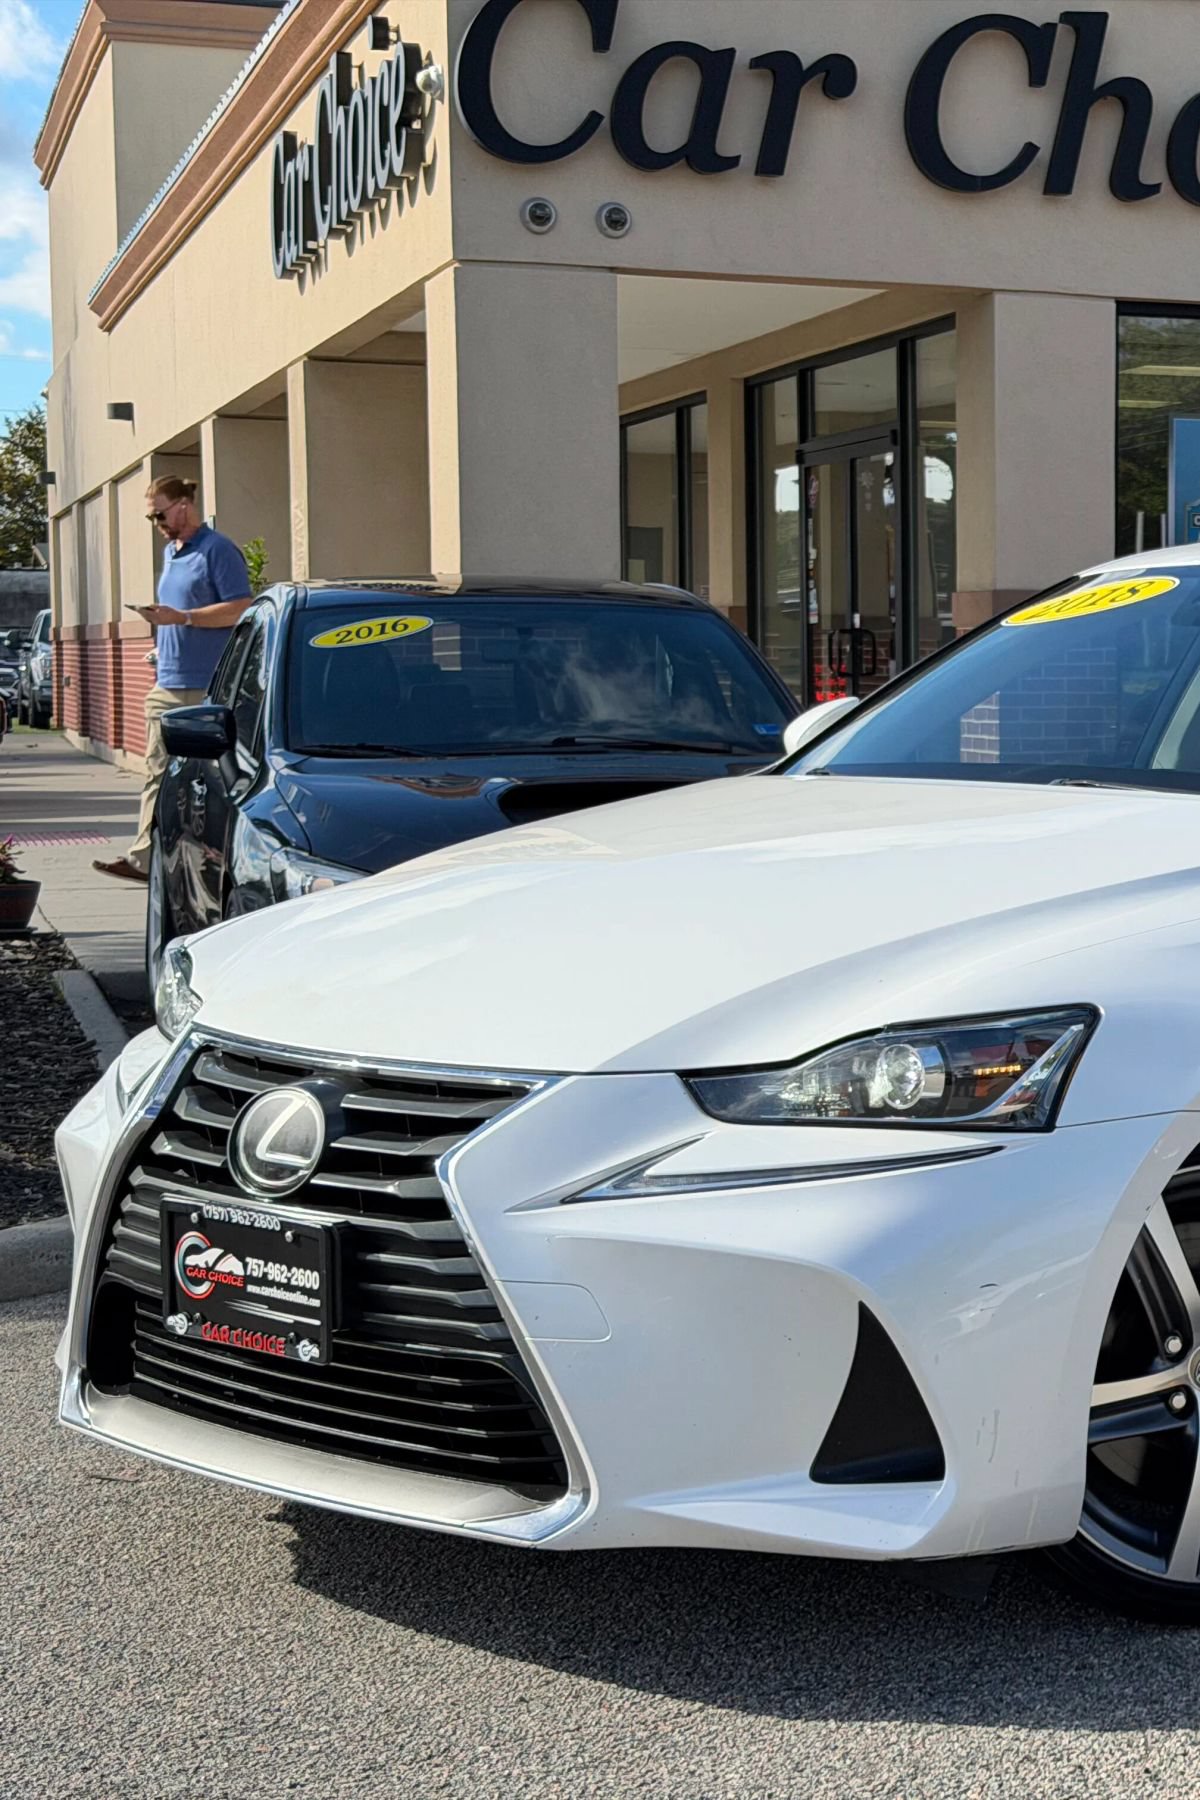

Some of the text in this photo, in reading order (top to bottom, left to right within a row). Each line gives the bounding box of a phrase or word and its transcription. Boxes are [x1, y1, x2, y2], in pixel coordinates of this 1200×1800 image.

[457, 0, 857, 177] Car
[271, 14, 424, 279] Car Choice
[1023, 581, 1156, 621] 2018
[335, 617, 410, 645] 2016
[229, 1208, 281, 1231] 962-2600
[186, 1266, 245, 1288] CAR CHOICE
[245, 1257, 320, 1290] 757-962-2600
[246, 1284, 321, 1308] www.carchoiceonline.com
[201, 1321, 286, 1356] CAR CHOICE
